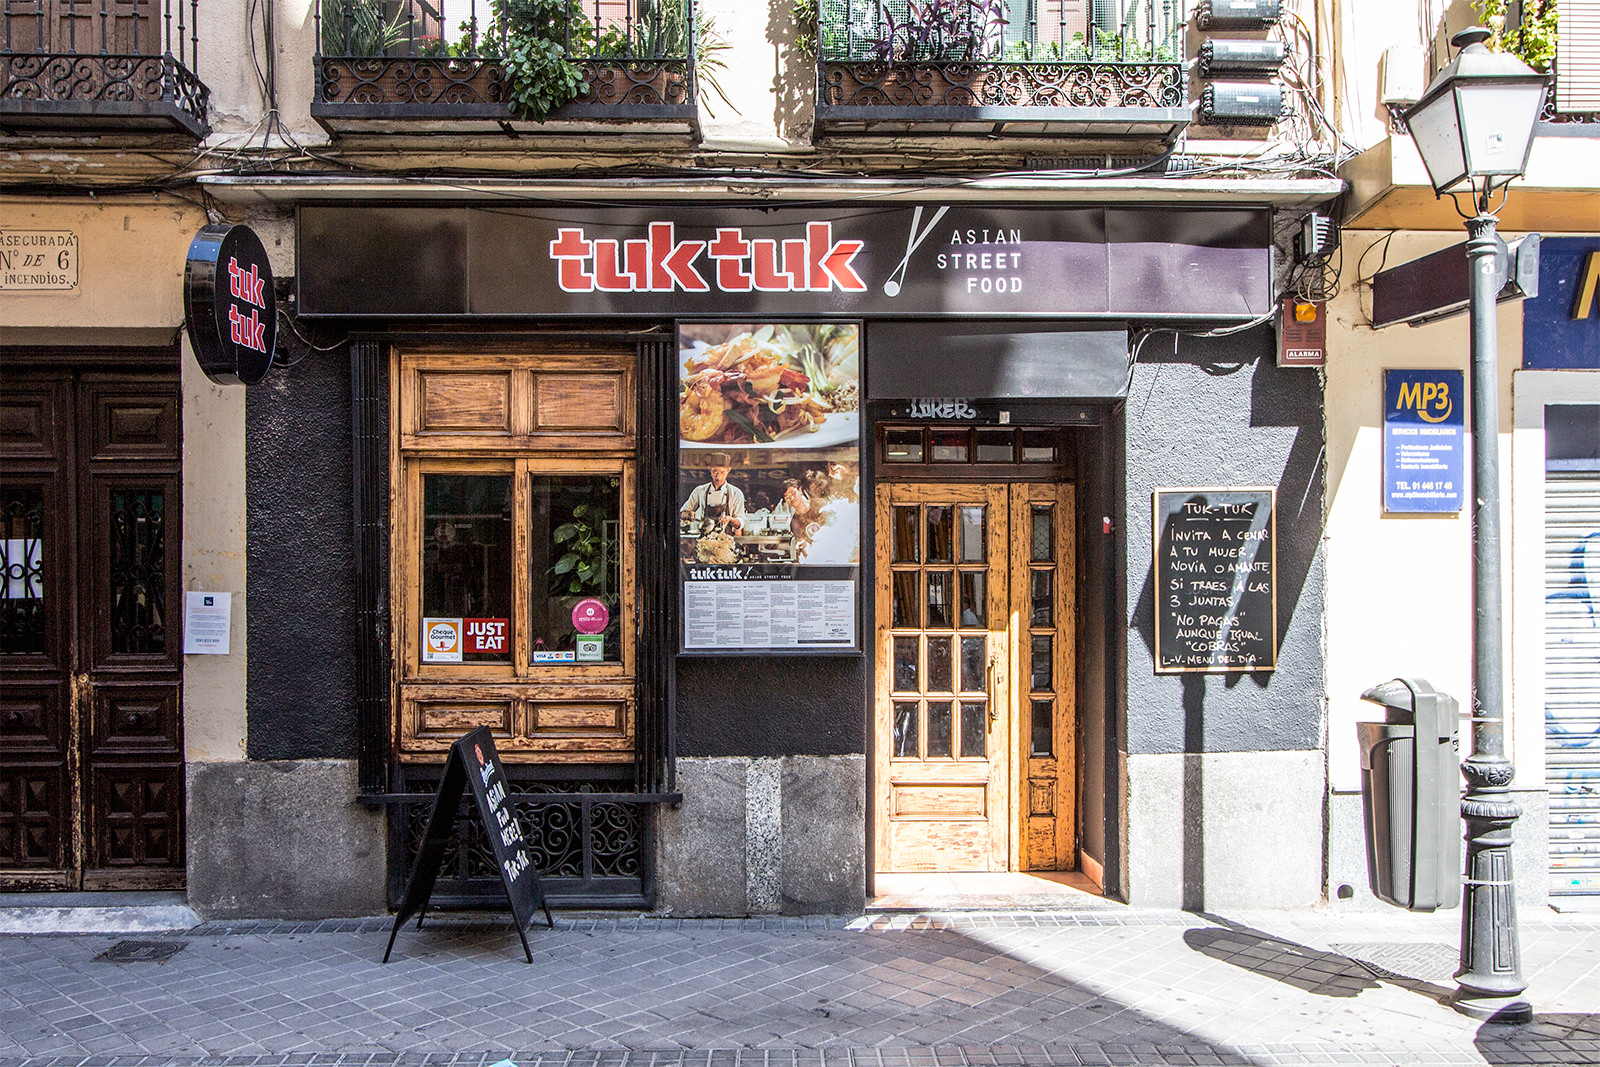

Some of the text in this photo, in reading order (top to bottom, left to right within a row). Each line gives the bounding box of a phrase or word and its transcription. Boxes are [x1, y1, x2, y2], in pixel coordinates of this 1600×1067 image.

[951, 229, 1021, 245] ASIAN
[22, 254, 45, 267] DE
[57, 250, 70, 270] 6
[937, 253, 1021, 269] STREET
[228, 256, 266, 310] tuk
[967, 277, 1022, 293] FOOD
[228, 304, 267, 354] tuk
[1396, 382, 1450, 410] MP3
[1183, 502, 1254, 515] TUK-TUK
[1222, 529, 1232, 541] A
[1236, 528, 1270, 541] CENAR
[1170, 545, 1178, 557] A
[1183, 546, 1198, 556] TU
[1190, 581, 1227, 591] TRAES
[1248, 582, 1270, 594] LAS
[1170, 595, 1234, 608] 3 JUNTAS
[466, 622, 505, 636] JUST
[1175, 628, 1263, 641] AUNQUE IGUAL
[475, 636, 505, 650] EAT
[1217, 655, 1235, 663] DEL
[485, 780, 506, 814] ASIAN
